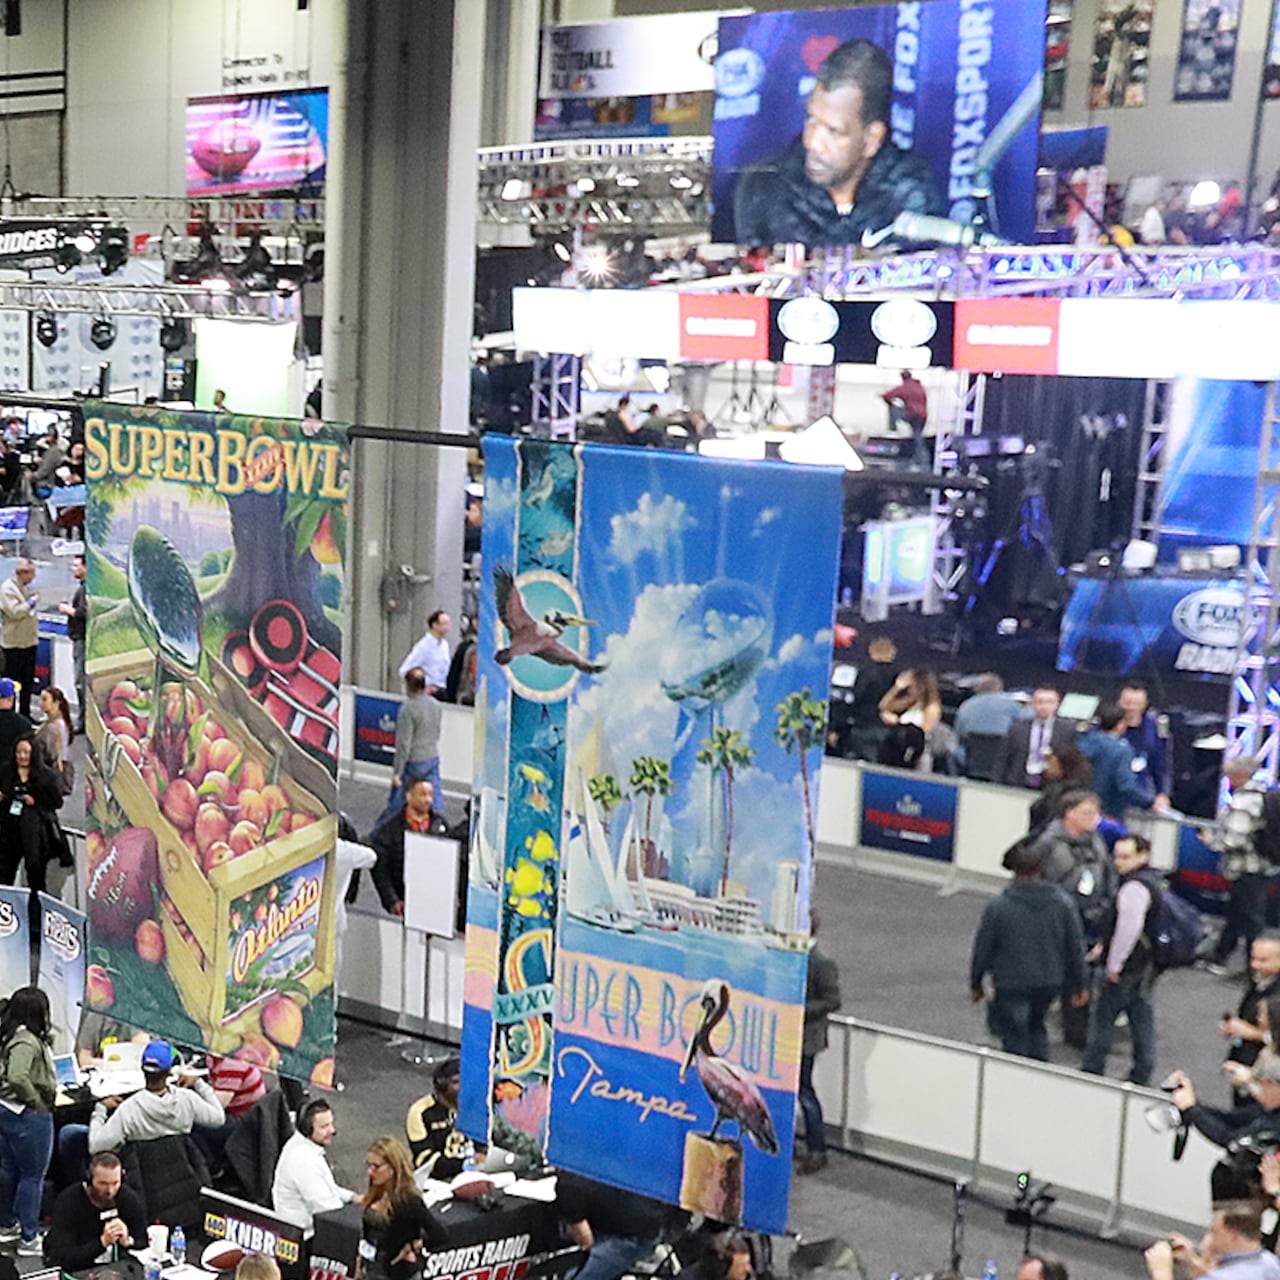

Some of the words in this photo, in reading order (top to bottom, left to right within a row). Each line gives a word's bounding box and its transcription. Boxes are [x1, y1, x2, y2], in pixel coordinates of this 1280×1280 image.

[85, 417, 216, 485] SUPER
[216, 428, 351, 499] BOWL
[495, 988, 554, 1018] XXXV
[557, 1045, 697, 1122] Tampa
[225, 1216, 276, 1257] KNBR
[423, 1243, 481, 1279] SPORTS
[481, 1232, 531, 1265] RADIO
